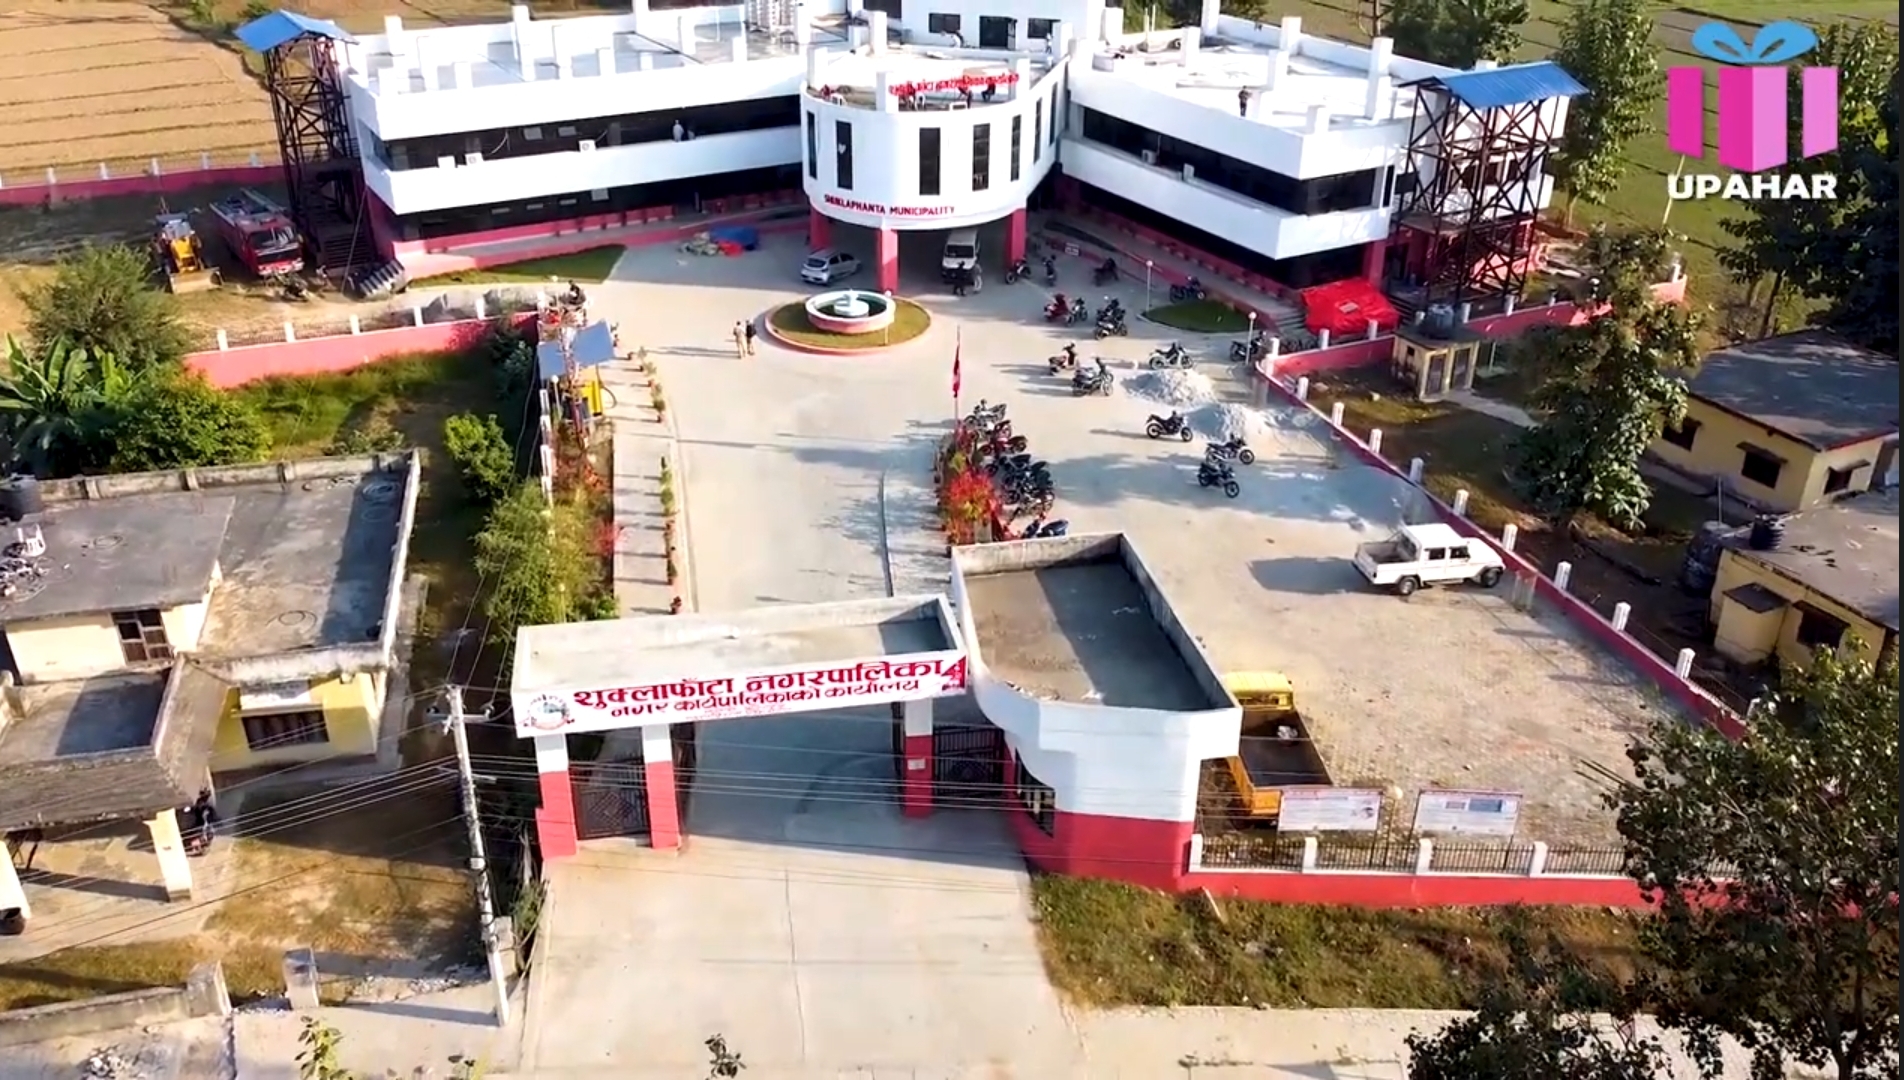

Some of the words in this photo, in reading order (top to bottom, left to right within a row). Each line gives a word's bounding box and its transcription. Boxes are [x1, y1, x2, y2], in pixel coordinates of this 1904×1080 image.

[889, 206, 955, 216] MUNICIPALITY
[746, 660, 944, 692] नगरपालिका
[611, 702, 669, 717] नगर
